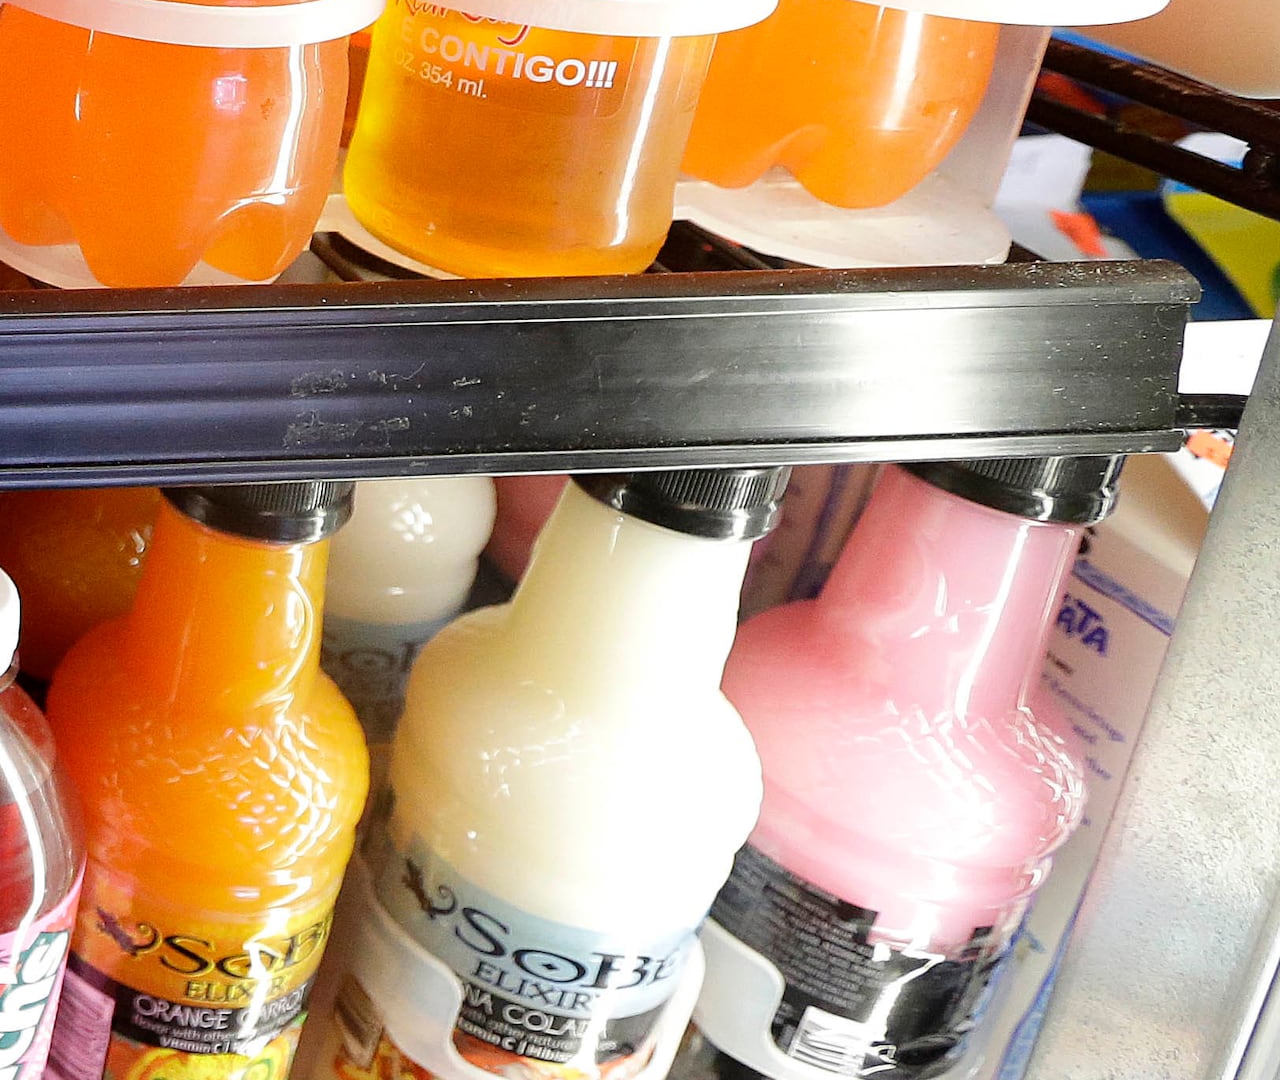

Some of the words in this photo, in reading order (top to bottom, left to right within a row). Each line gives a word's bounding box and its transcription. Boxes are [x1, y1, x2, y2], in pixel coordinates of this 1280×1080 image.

[421, 26, 618, 89] CONTIGO!!!
[419, 61, 453, 87] 354
[457, 77, 488, 99] ml.
[184, 980, 288, 1004] ELIXR
[133, 993, 236, 1031] ORANGE
